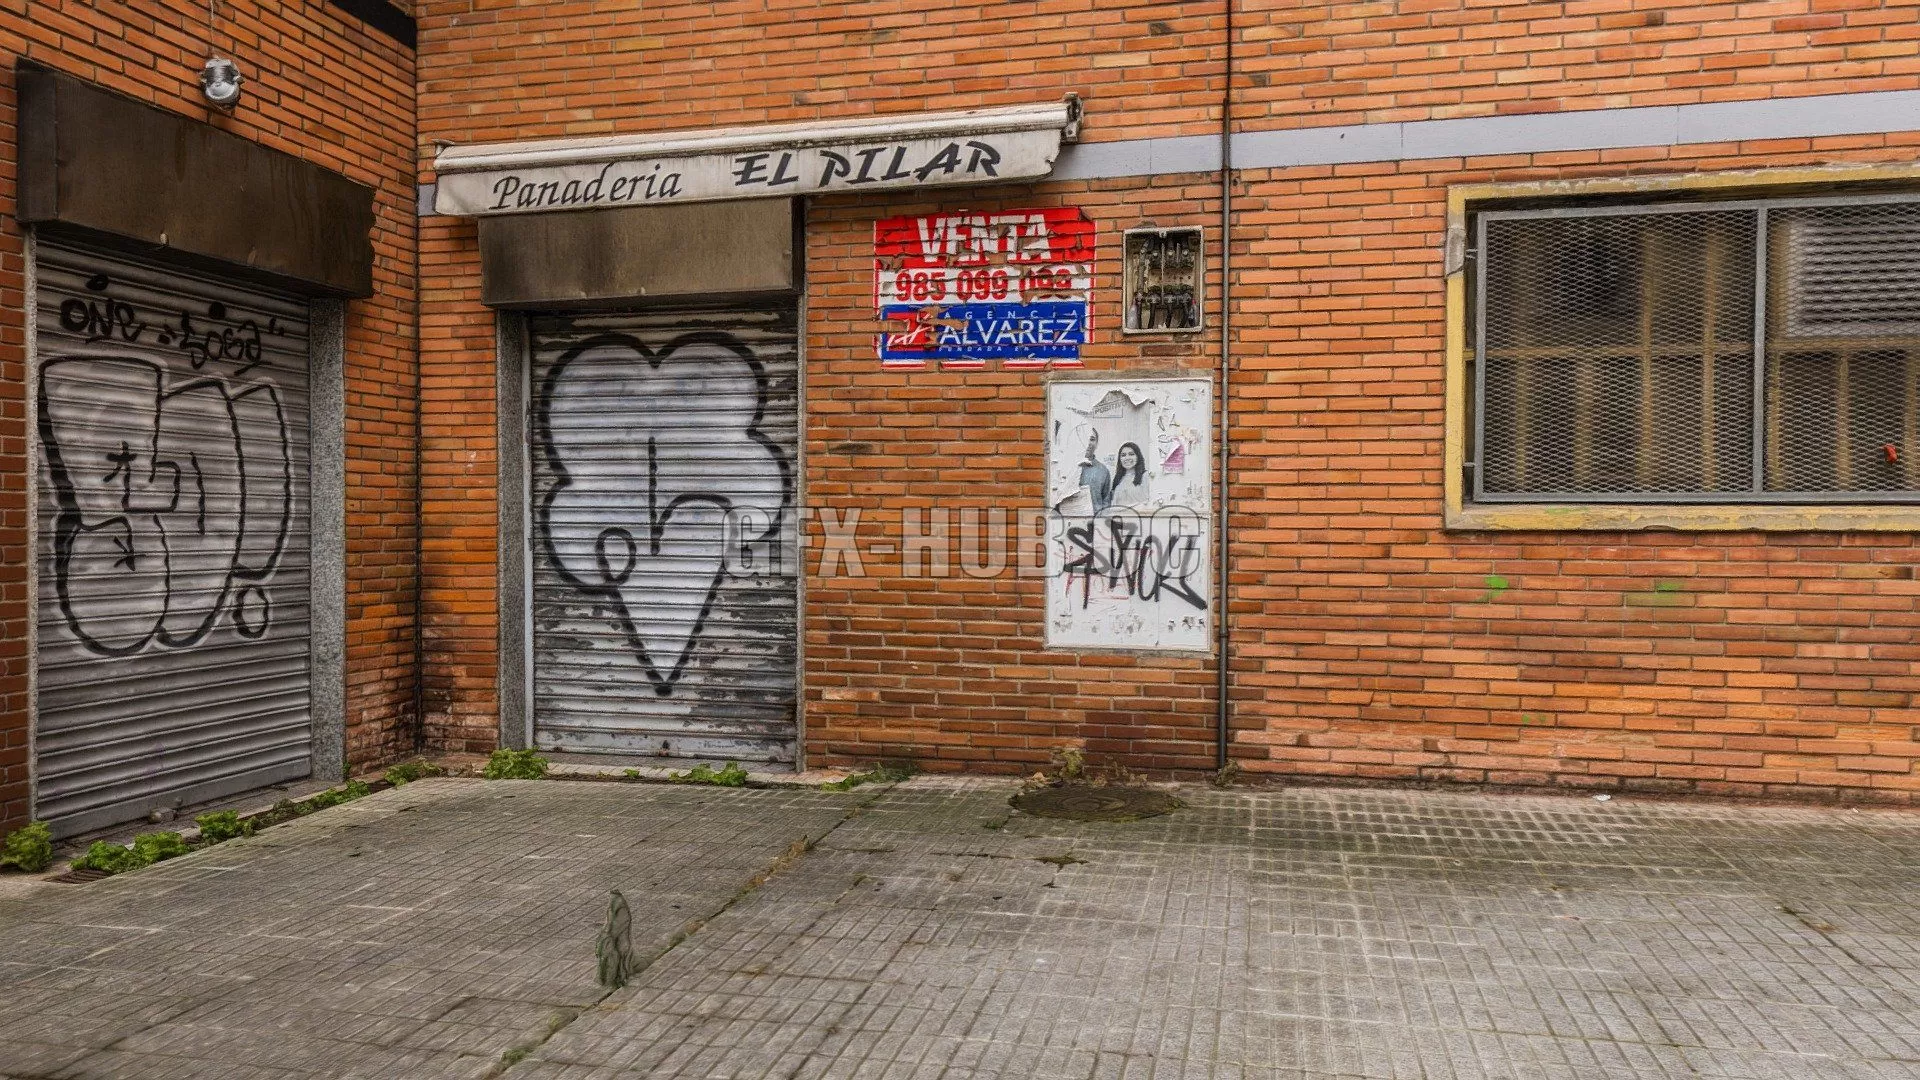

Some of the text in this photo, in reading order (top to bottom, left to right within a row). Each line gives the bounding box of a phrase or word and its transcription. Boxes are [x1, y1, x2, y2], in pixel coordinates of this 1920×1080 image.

[490, 139, 1002, 210] Panaderia EL PILAR
[917, 213, 1051, 263] VENTA
[895, 270, 947, 302] 985
[956, 269, 1009, 301] 099
[939, 318, 1079, 345] ALVAREZ
[944, 310, 1079, 320] AGENCIA
